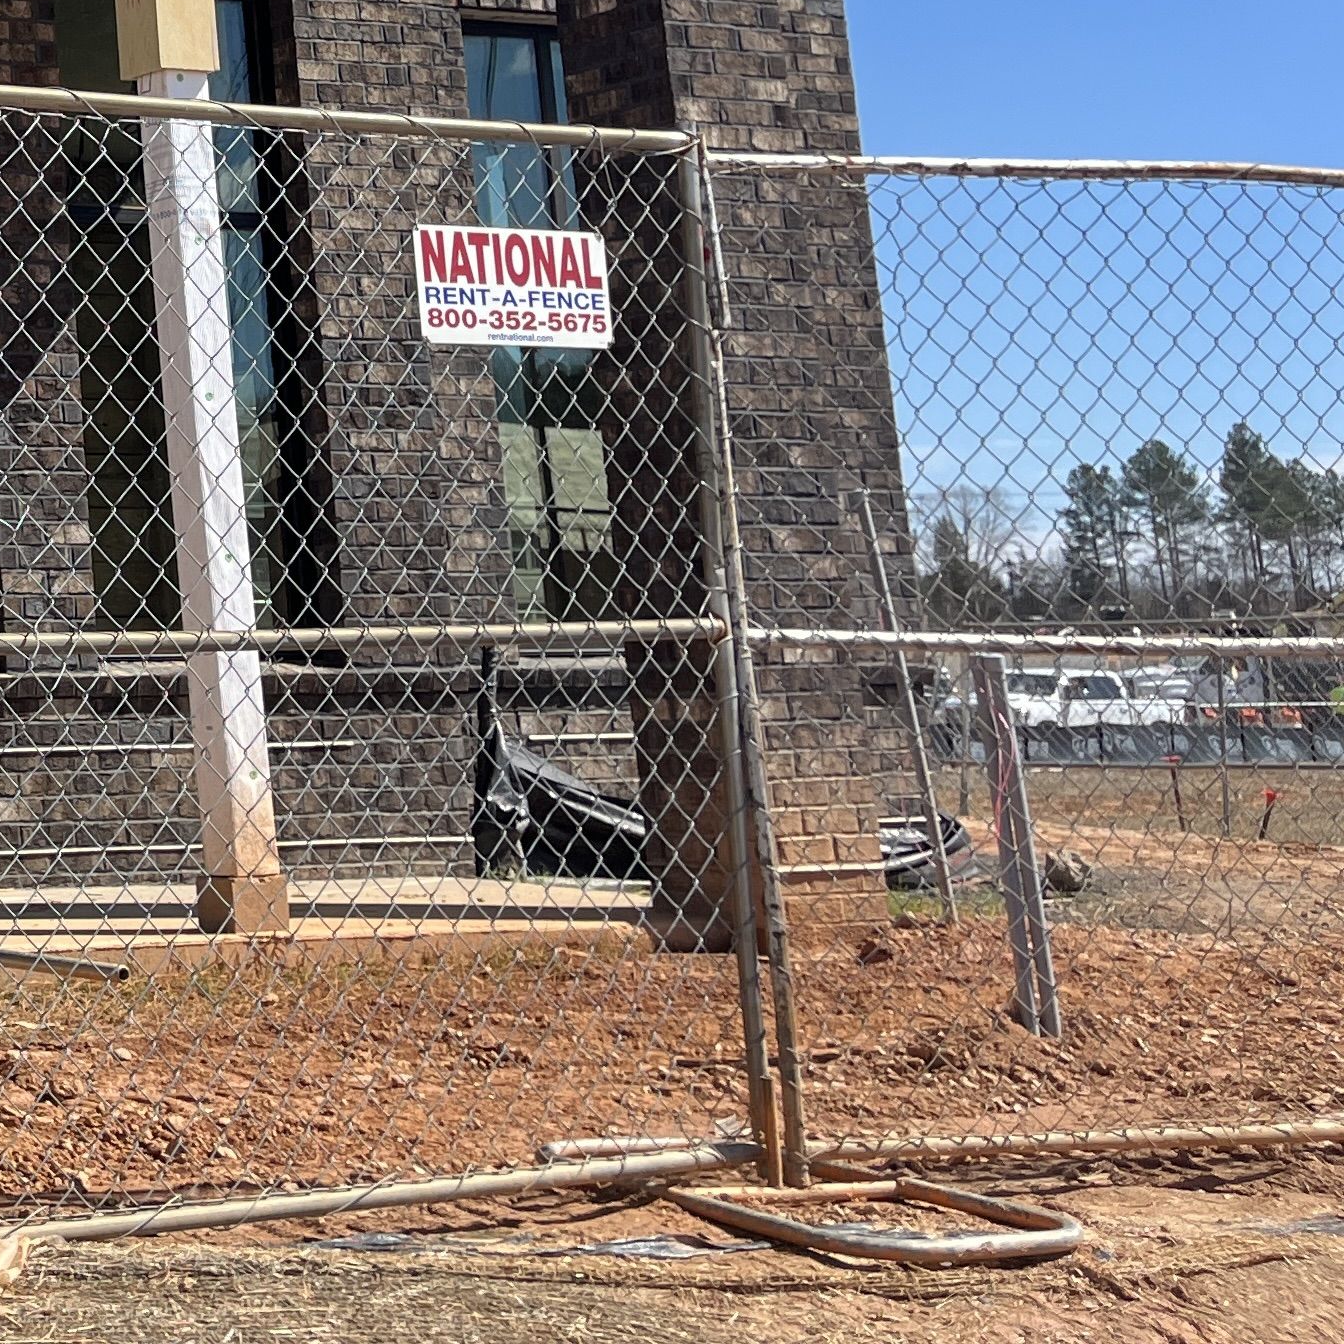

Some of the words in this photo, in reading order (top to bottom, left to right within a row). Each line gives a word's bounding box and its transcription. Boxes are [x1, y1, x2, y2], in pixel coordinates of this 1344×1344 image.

[420, 229, 603, 290] NATIONAL
[424, 286, 606, 311] RENT-A-FENCE
[427, 307, 607, 333] 800-352-5675
[487, 332, 554, 342] rentnational.com
